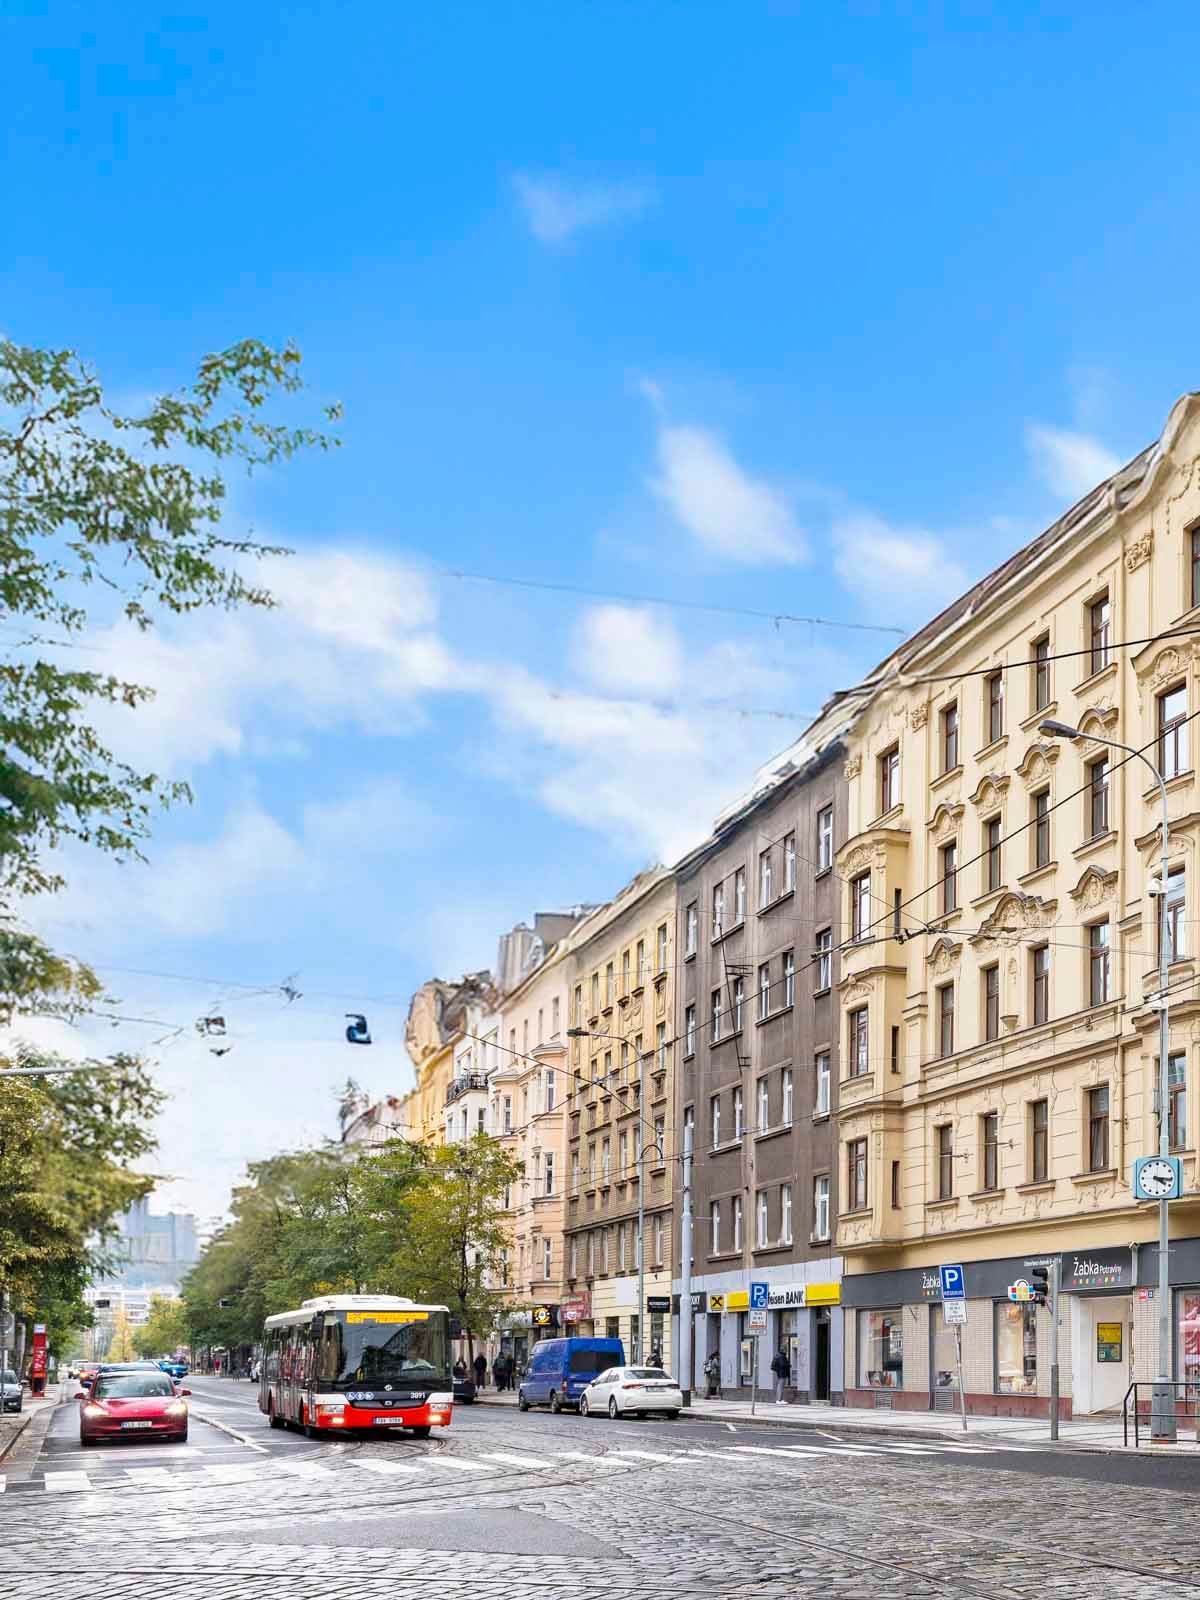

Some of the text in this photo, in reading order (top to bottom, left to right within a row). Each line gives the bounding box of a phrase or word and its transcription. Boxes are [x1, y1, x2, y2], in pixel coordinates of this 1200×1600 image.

[1073, 1257, 1100, 1276] Žabka
[922, 1273, 941, 1289] Žabka
[945, 1269, 958, 1289] P
[785, 1288, 804, 1305] BANK
